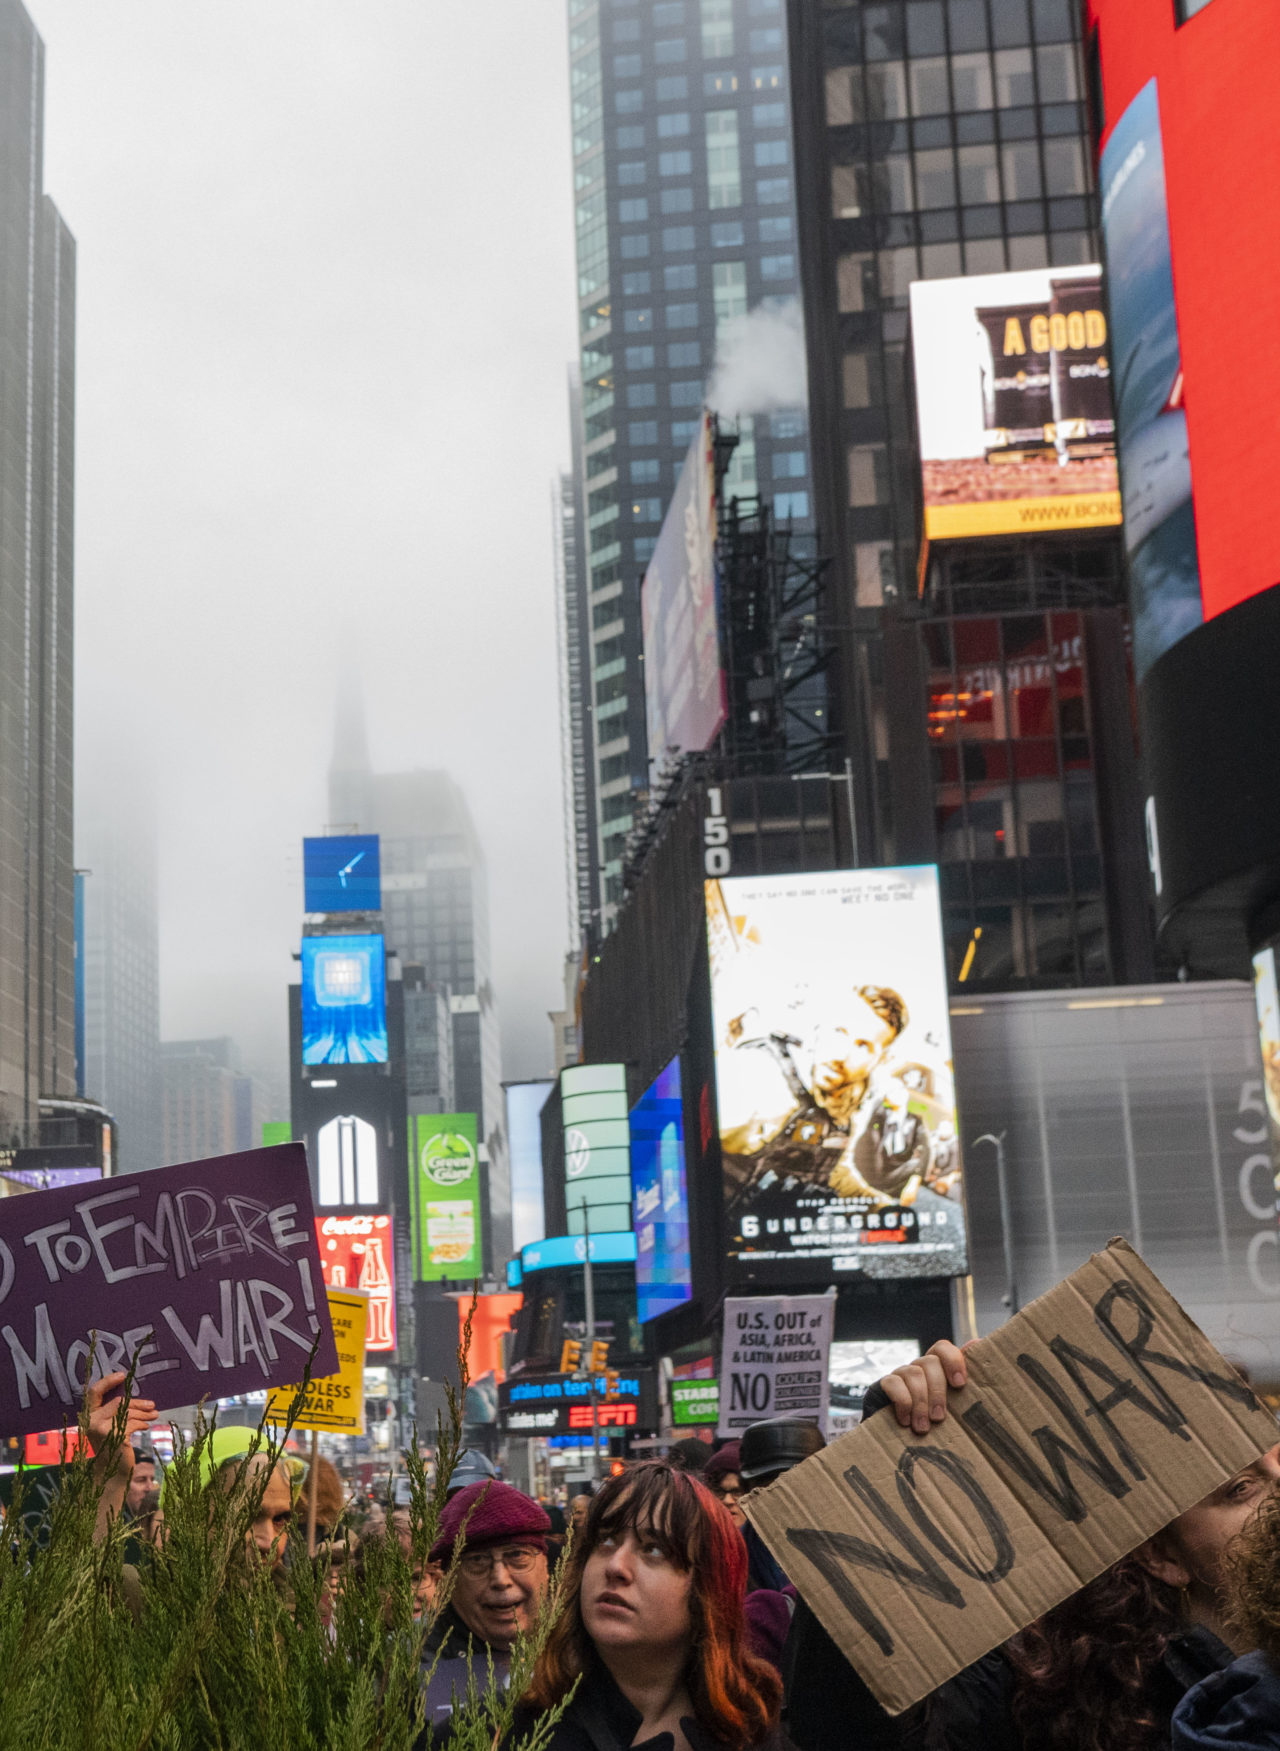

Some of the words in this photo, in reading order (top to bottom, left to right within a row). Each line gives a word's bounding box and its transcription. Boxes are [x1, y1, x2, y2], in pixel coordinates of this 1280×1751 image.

[1004, 317, 1026, 356] A
[1030, 310, 1108, 354] GOOD
[1019, 502, 1121, 522] WWW.BON
[704, 788, 731, 875] 150
[741, 1216, 760, 1238] 6
[766, 1210, 948, 1234] UNDERGROUND
[160, 1257, 320, 1379] WAR!
[331, 1317, 353, 1328] CARE
[737, 1312, 769, 1329] U.S.
[774, 1312, 807, 1330] OUT
[810, 1315, 823, 1328] of
[334, 1330, 346, 1338] ON
[739, 1333, 771, 1348] ASIA,
[773, 1332, 816, 1347] AFRICA,
[337, 1353, 357, 1363] EDS
[732, 1351, 741, 1363] &
[743, 1351, 774, 1363] LATIN
[776, 1349, 822, 1363] AMERICA
[674, 1387, 719, 1402] STARB
[729, 1373, 771, 1411] NO
[301, 1396, 335, 1412] WAR
[785, 1445, 1016, 1658] NO
[961, 1280, 1261, 1525] WAR
